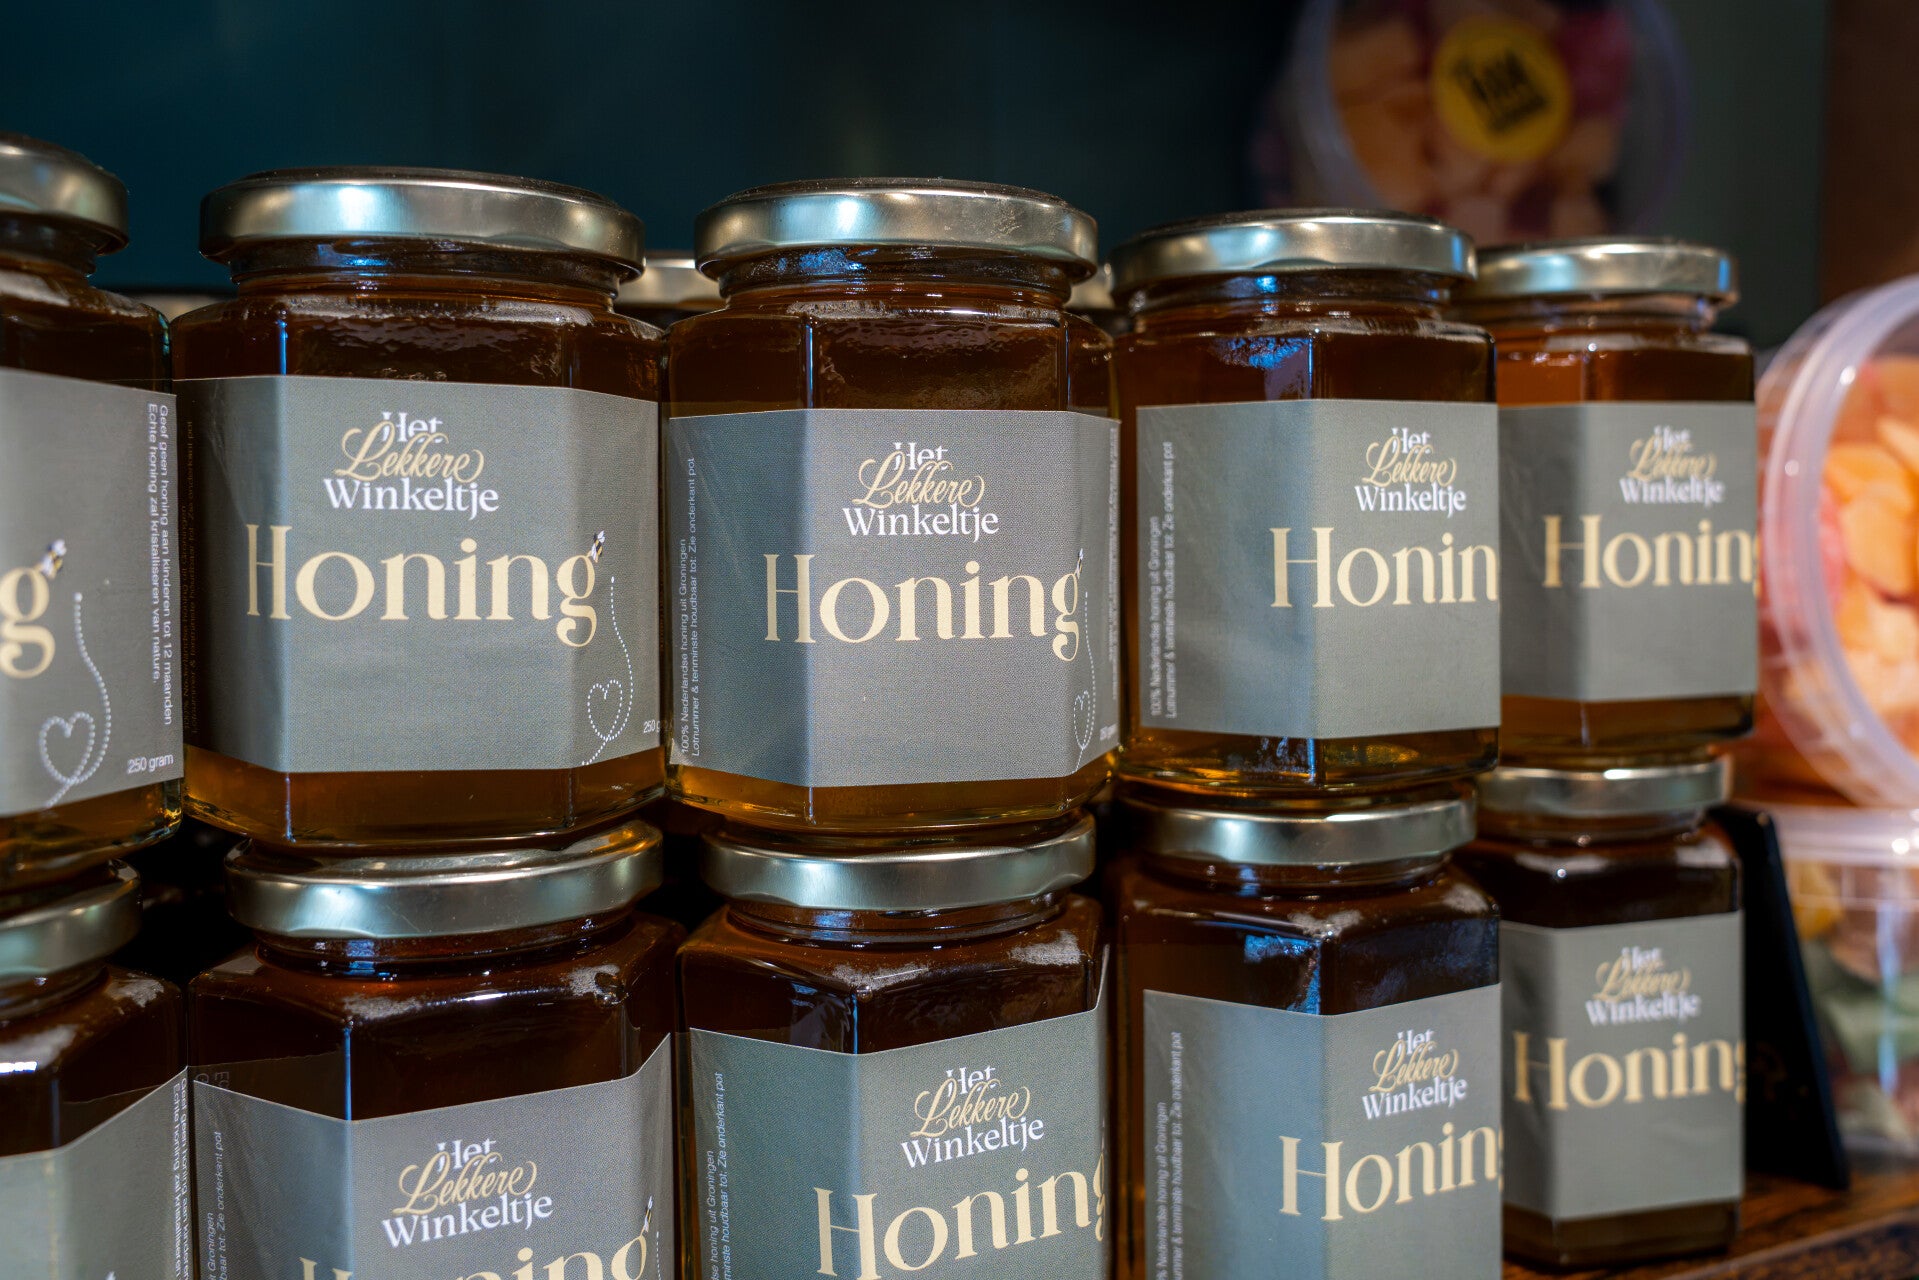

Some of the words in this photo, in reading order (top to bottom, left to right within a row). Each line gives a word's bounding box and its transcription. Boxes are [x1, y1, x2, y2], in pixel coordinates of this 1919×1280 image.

[148, 403, 158, 443] Echte
[159, 405, 169, 439] Geef
[381, 411, 444, 443] Het
[1391, 427, 1433, 454] Het
[148, 446, 159, 493] honing
[159, 441, 168, 476] geen
[334, 420, 485, 483] Lekkere
[688, 457, 697, 476] pot
[894, 442, 949, 471] Het
[1361, 435, 1458, 487] Lekkere
[323, 477, 500, 521] Winkeltje
[852, 450, 985, 509] Lekkere
[1354, 481, 1467, 519] Winkeltje
[150, 497, 160, 517] zal
[160, 480, 170, 526] honing
[688, 478, 697, 534] onderkant
[842, 503, 1000, 543] Winkeltje
[150, 519, 161, 603] kristalliseren
[161, 529, 170, 556] aan
[688, 536, 698, 553] Zie
[1541, 514, 1761, 599] Honin
[162, 559, 172, 617] kinderen
[246, 523, 600, 648] Honing
[678, 539, 689, 596] Groningen
[1269, 526, 1499, 609] Honin
[152, 606, 161, 633] van
[679, 599, 688, 611] uit
[689, 576, 699, 628] houdbaar
[763, 552, 1081, 663] Honing
[163, 620, 172, 639] tot
[163, 644, 173, 658] 12
[680, 613, 690, 650] honing
[152, 636, 161, 684] nature.
[690, 630, 699, 683] tenminste
[163, 661, 174, 726] maanden
[680, 653, 689, 722] Nederlandse
[690, 685, 699, 694] &
[643, 719, 656, 734] 250
[681, 724, 689, 754] 100%
[691, 695, 700, 757] Lotnummer
[127, 757, 147, 774] 250
[149, 754, 175, 773] gram
[714, 1071, 725, 1091] pot
[945, 1064, 997, 1098] Het
[1368, 1038, 1459, 1093] Lekkere
[715, 1093, 727, 1149] onderkant
[909, 1077, 1031, 1139] Lekkere
[1361, 1076, 1468, 1121] Winkeltje
[213, 1131, 224, 1151] pot
[437, 1137, 497, 1172] Het
[717, 1150, 728, 1168] Zie
[900, 1117, 1046, 1169] Winkeltje
[214, 1152, 225, 1210] onderkant
[391, 1150, 538, 1216] Lekkere
[705, 1150, 717, 1207] Groningen
[1279, 1121, 1504, 1222] Honin
[382, 1192, 554, 1249] Winkeltje
[708, 1209, 718, 1224] uit
[719, 1189, 731, 1243] houdbaar
[813, 1153, 1107, 1280] Honing
[206, 1212, 217, 1271] Groningen
[709, 1225, 720, 1263] honing
